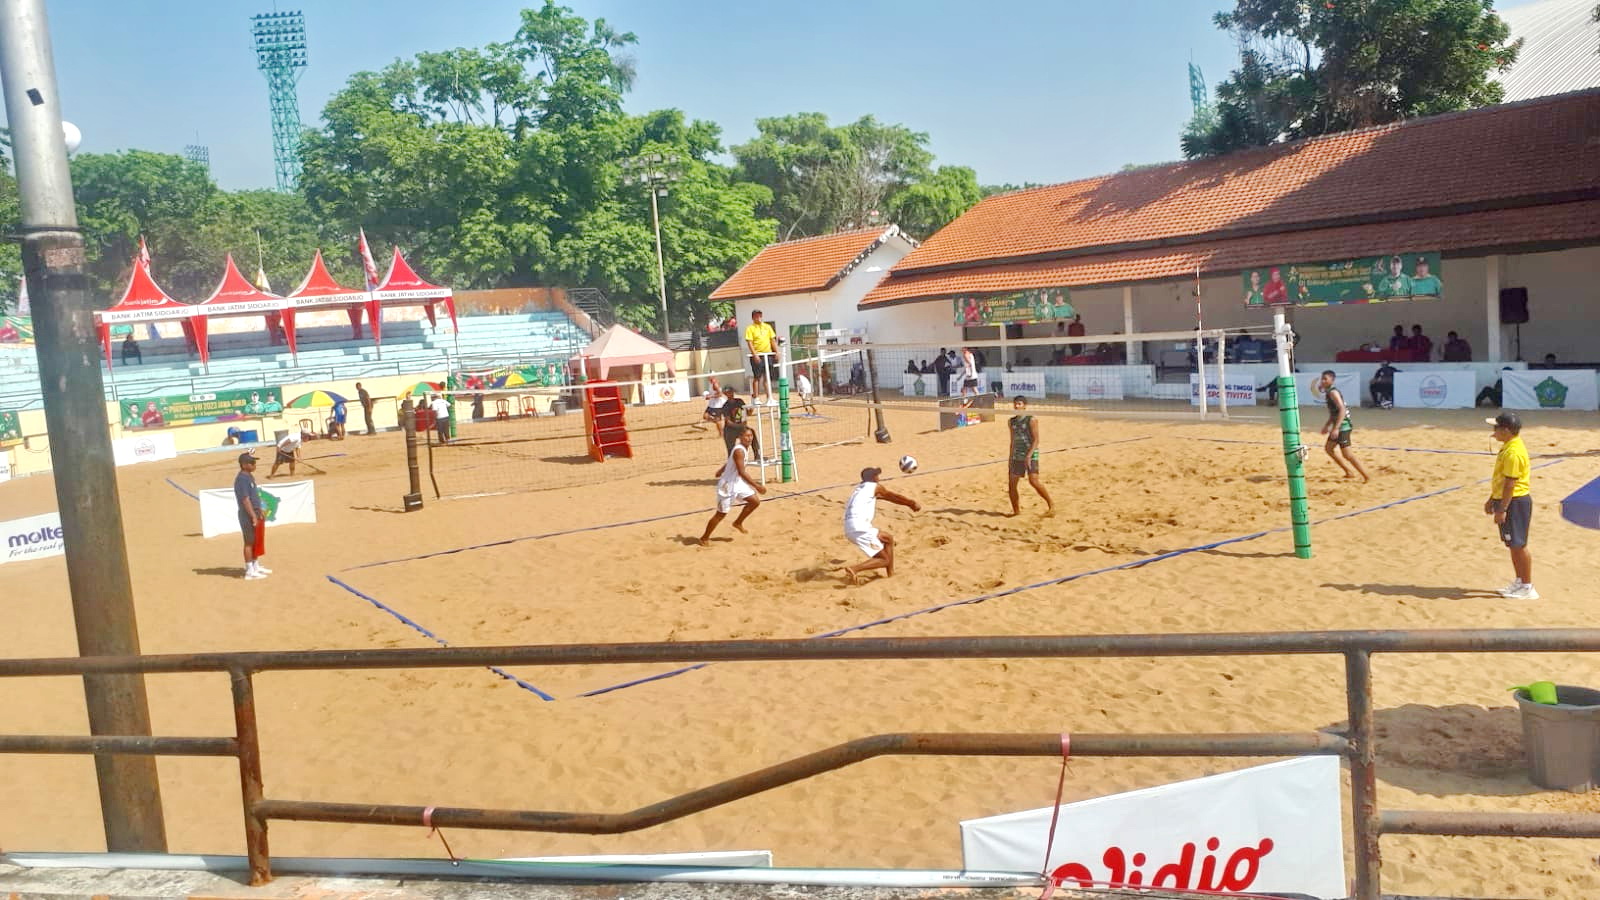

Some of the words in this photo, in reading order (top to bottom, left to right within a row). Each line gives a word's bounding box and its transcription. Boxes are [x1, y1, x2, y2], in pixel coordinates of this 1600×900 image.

[111, 312, 130, 320] BANK
[133, 310, 153, 318] JATIM
[1206, 391, 1252, 399] SPOTIVITAS
